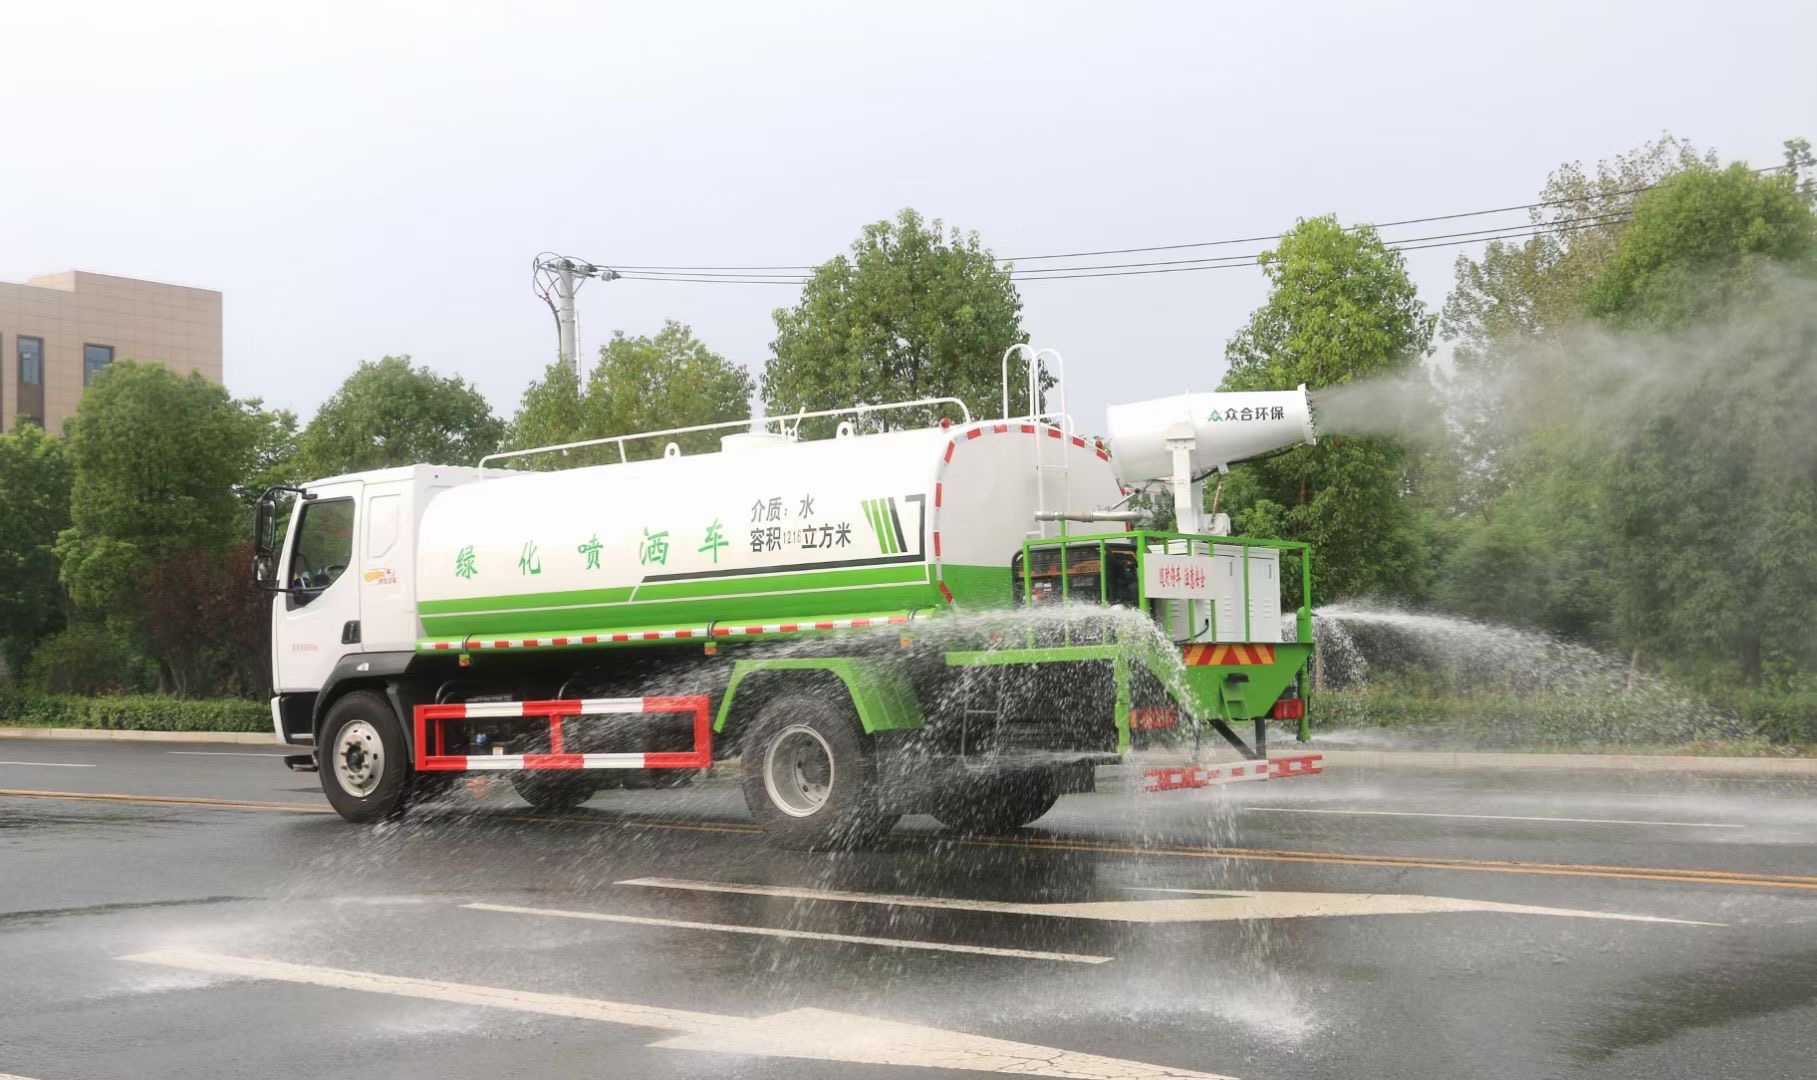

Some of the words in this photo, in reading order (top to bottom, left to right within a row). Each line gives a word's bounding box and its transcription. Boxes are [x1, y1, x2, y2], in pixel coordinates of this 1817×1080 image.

[1225, 406, 1285, 422] 众合环保
[455, 517, 729, 579] 绿化喷洒车
